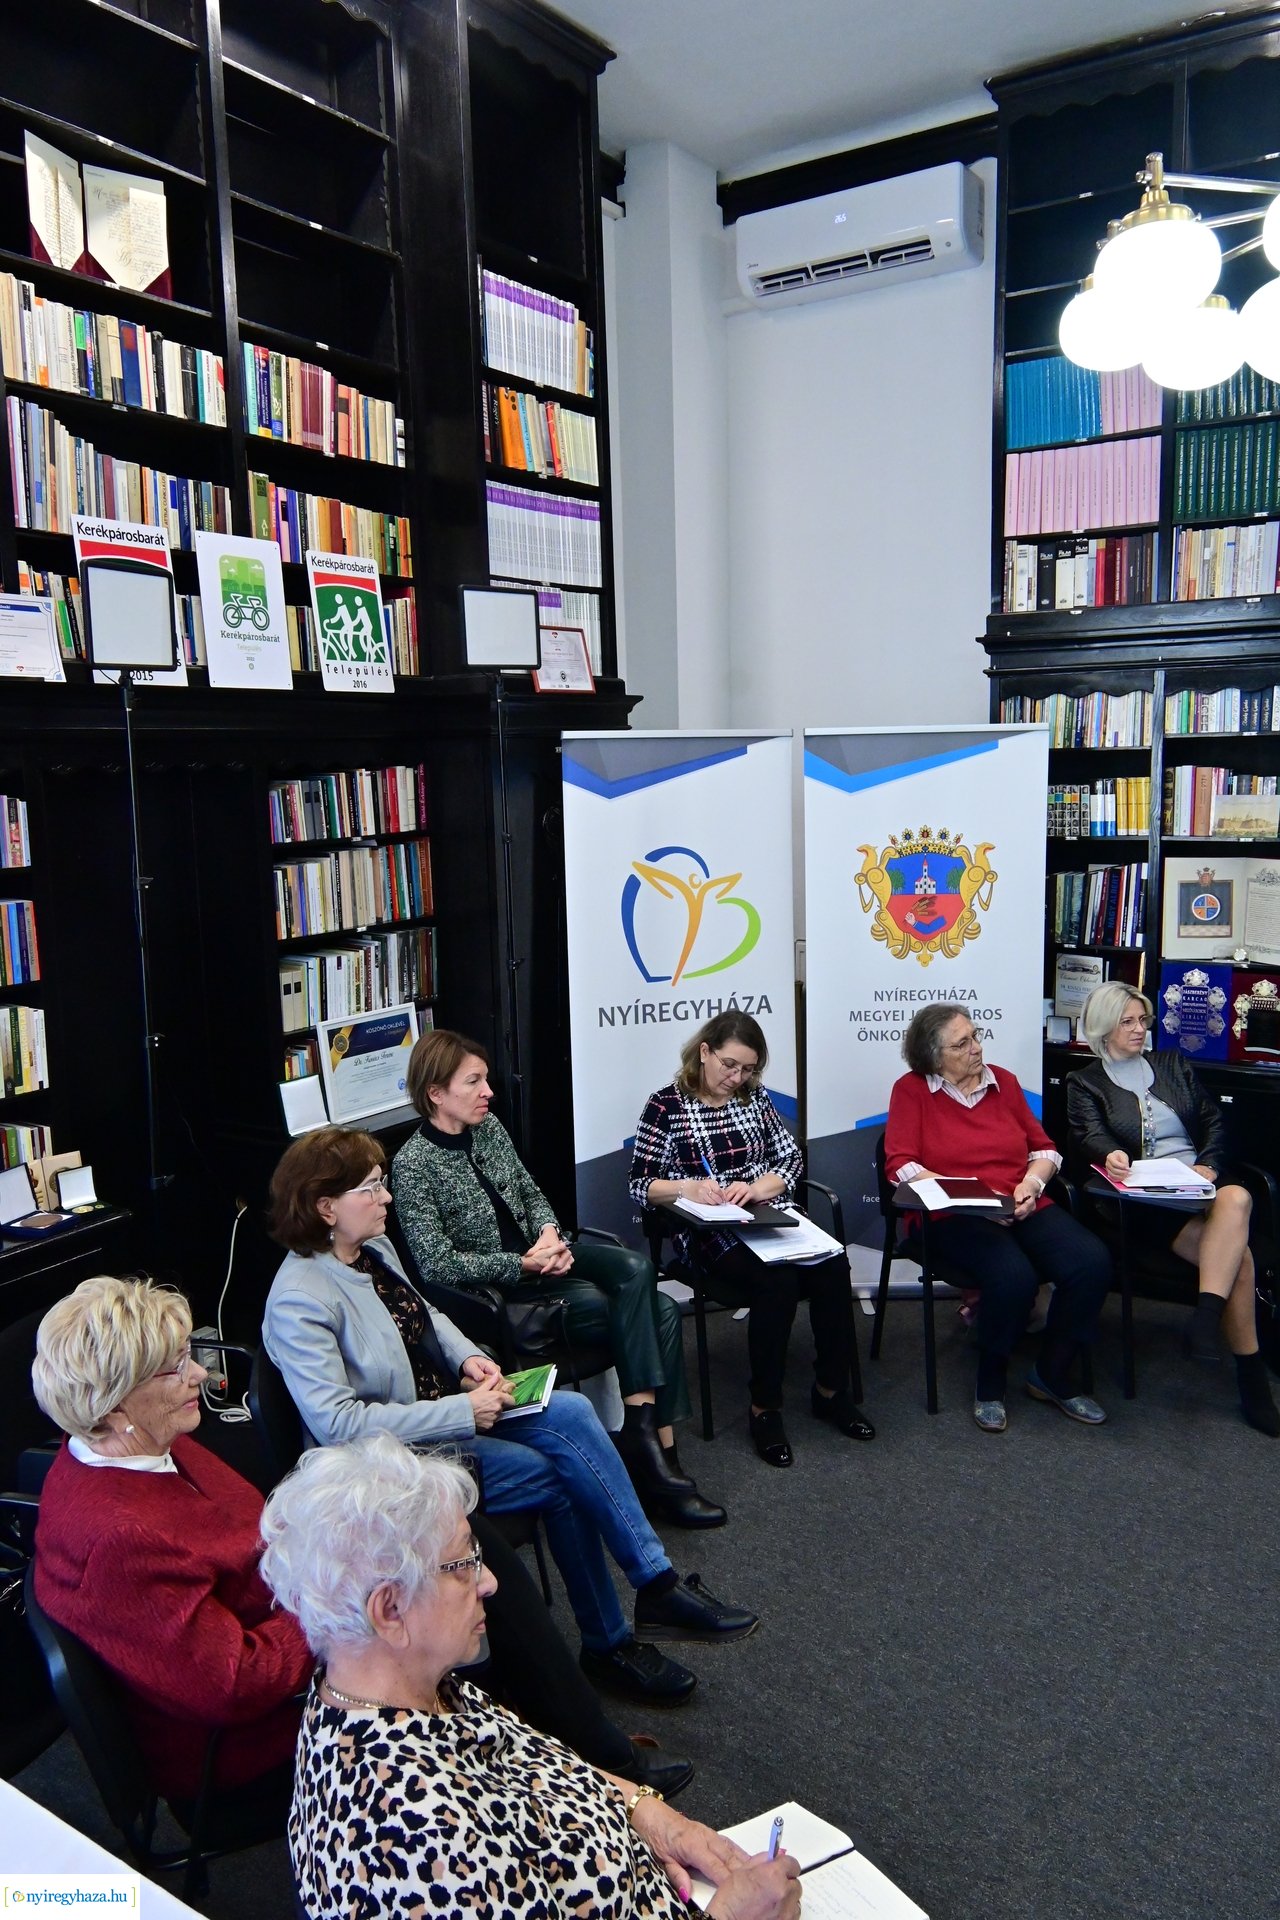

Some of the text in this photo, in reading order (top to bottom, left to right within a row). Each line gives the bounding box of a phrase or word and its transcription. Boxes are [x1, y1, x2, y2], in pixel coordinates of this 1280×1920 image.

[76, 521, 166, 547] Kerékpárosbarát
[311, 555, 375, 575] Kerékpárosbarát
[220, 630, 281, 643] Kerékpárosbarát
[131, 670, 154, 682] 2015
[325, 663, 389, 680] Település
[352, 679, 368, 689] 2016
[874, 986, 978, 1002] NYÍREGYHÁZA
[598, 991, 773, 1028] NYÍREGYHÁZA
[849, 1010, 905, 1022] MEGYEI
